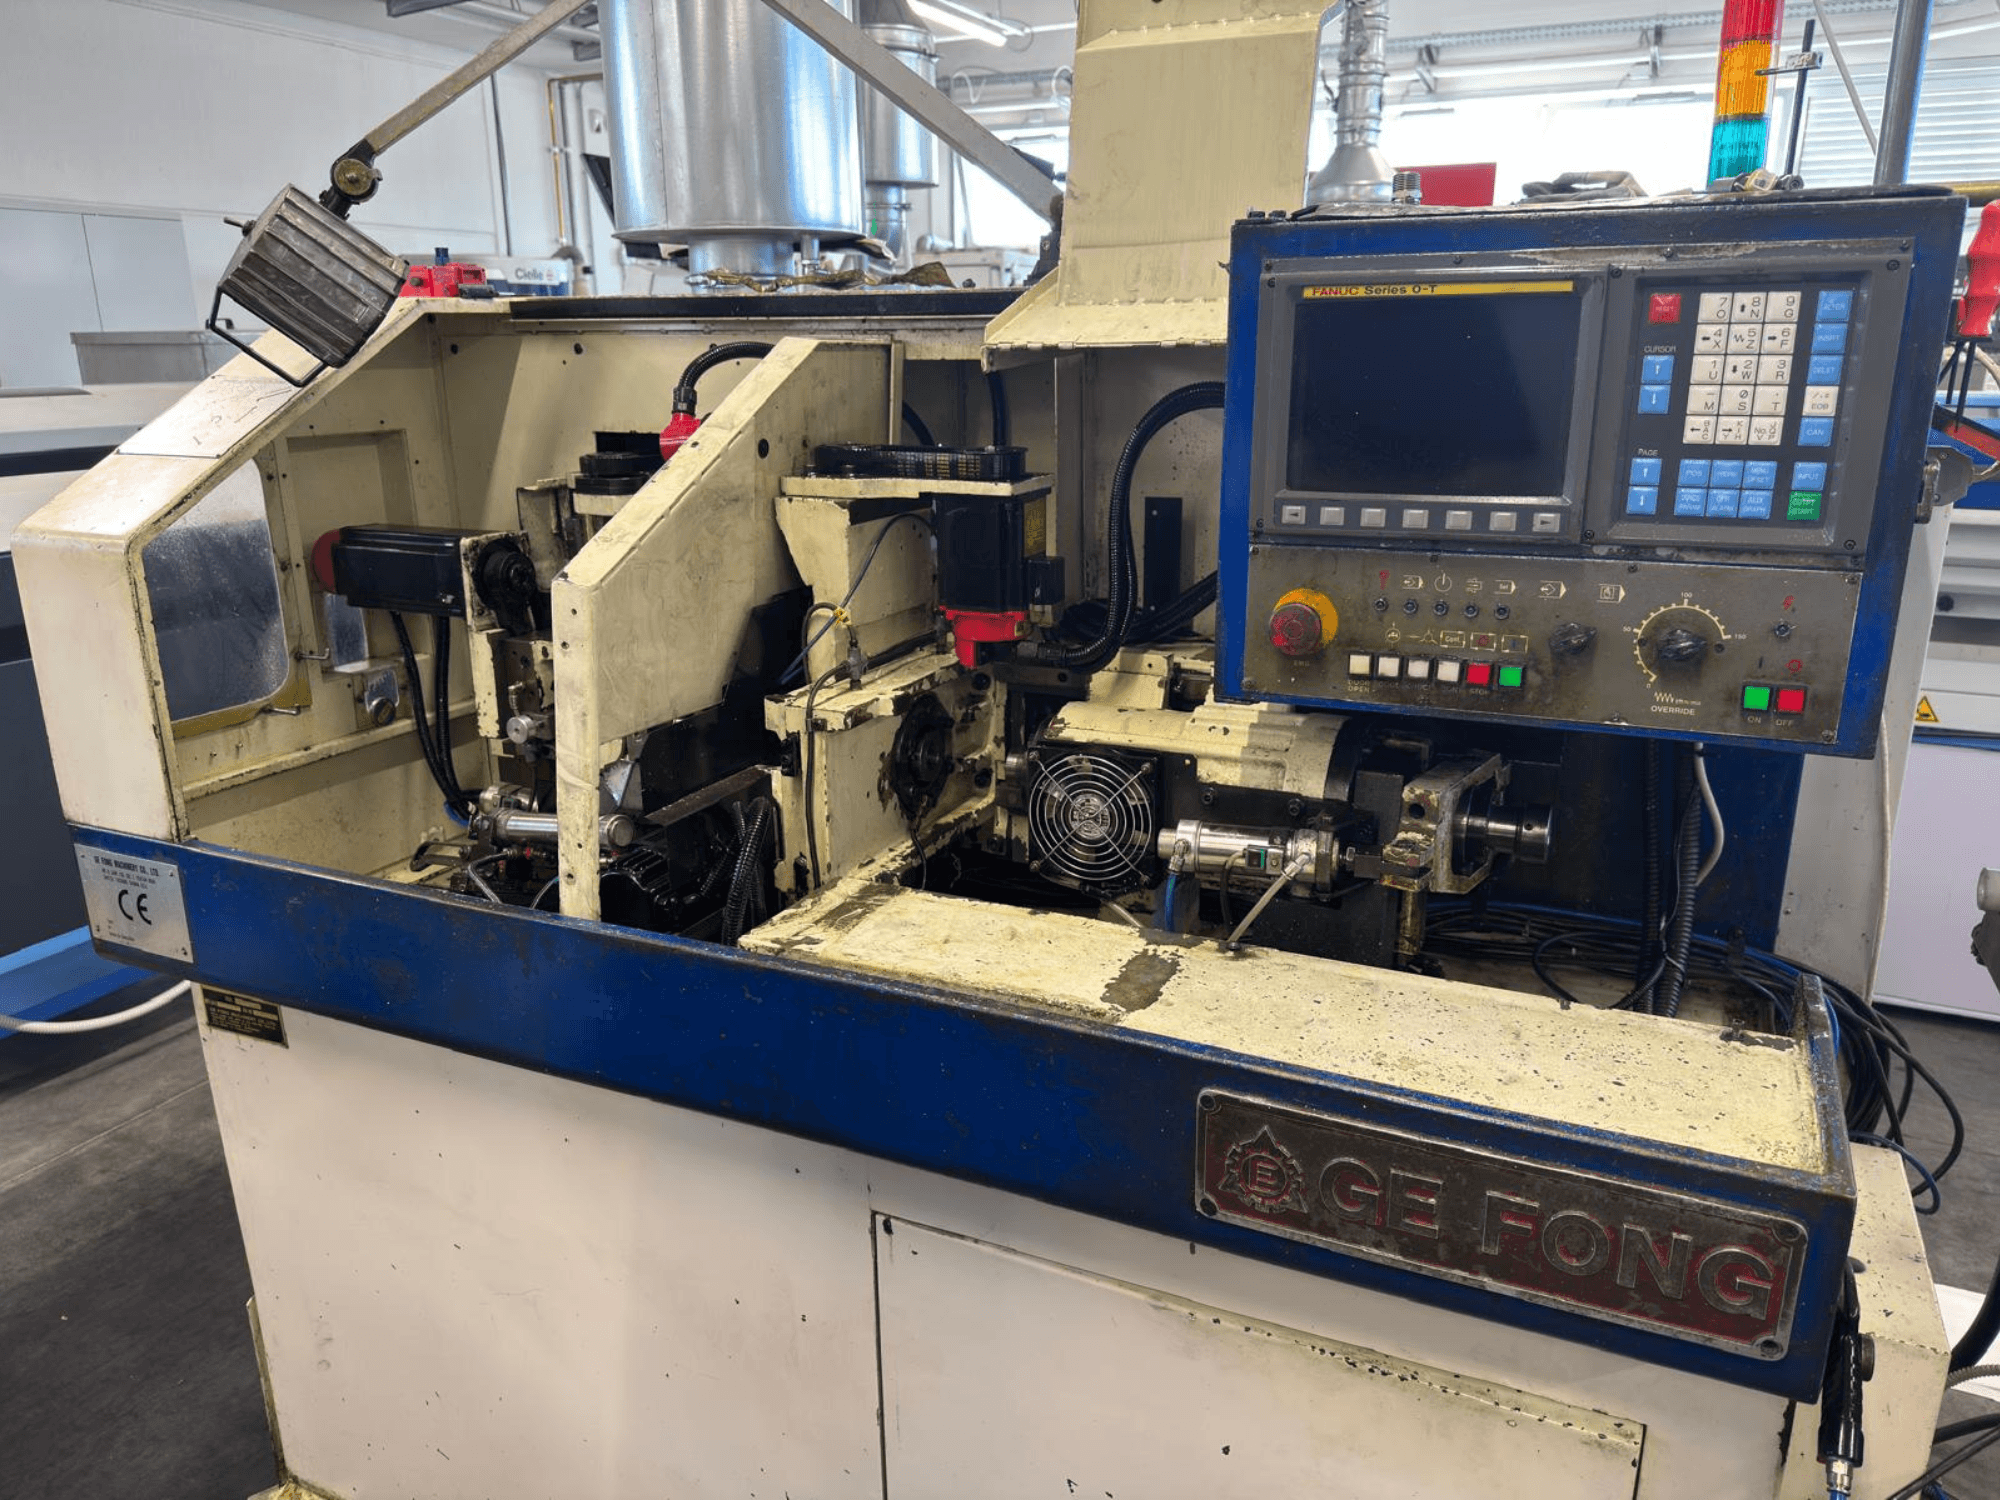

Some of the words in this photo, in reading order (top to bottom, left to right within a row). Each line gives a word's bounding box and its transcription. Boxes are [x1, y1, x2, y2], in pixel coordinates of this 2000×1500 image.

[1311, 286, 1359, 297] FANUC
[1364, 284, 1407, 296] Series
[1643, 344, 1677, 353] CURSOR
[1638, 448, 1659, 456] PAGE
[1651, 704, 1696, 716] OVERRIDE
[1747, 716, 1762, 724] ON
[1776, 718, 1795, 727] OFF
[1317, 1156, 1446, 1241] GE
[1480, 1189, 1776, 1321] FONG
